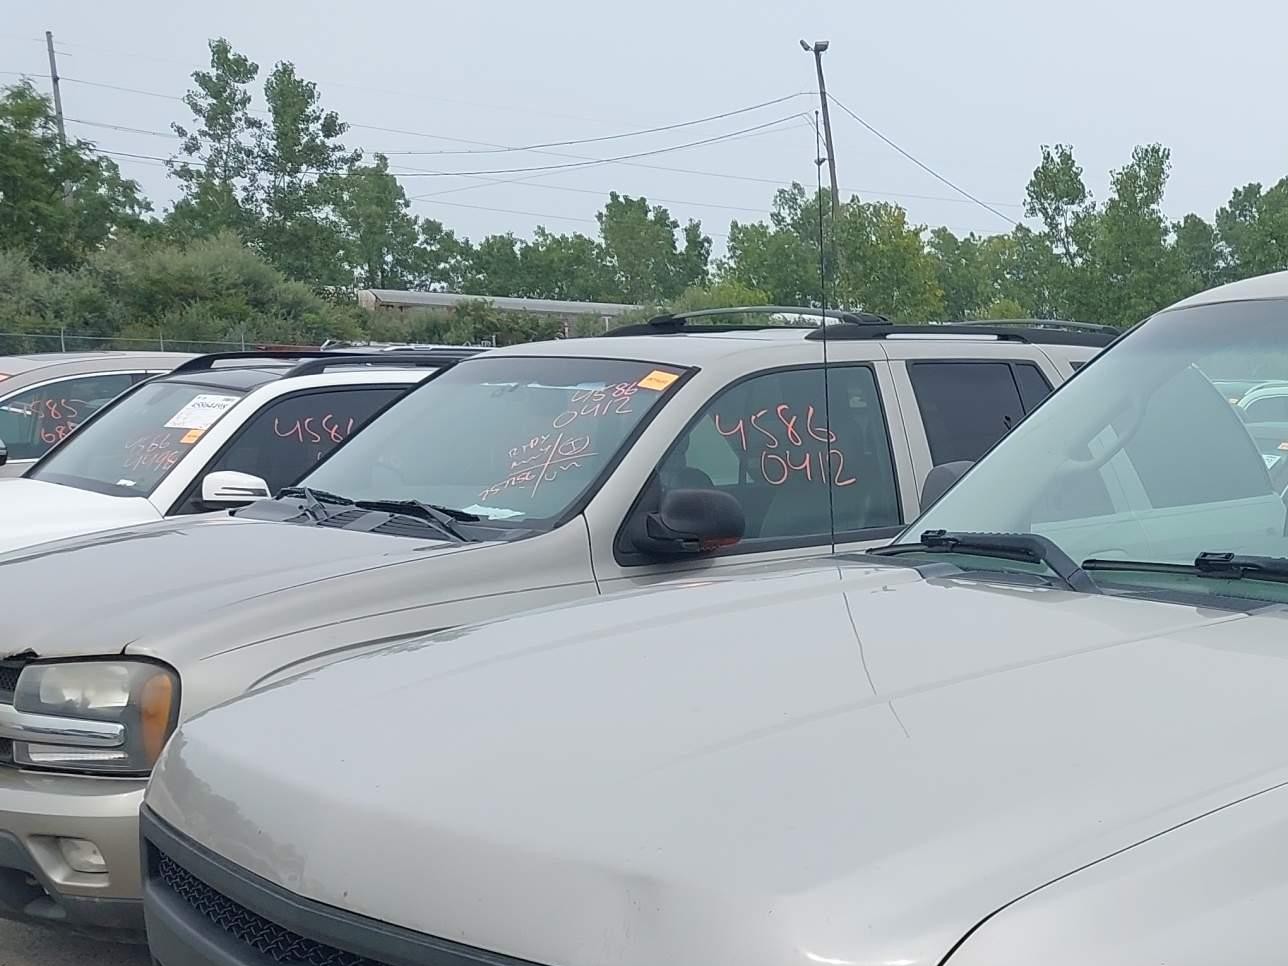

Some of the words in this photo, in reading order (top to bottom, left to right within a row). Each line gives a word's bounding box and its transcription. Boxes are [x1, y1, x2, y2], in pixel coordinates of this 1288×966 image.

[571, 382, 639, 403] 4586
[552, 397, 632, 429] 0412
[715, 405, 837, 450] 4586
[761, 449, 857, 487] 0412
